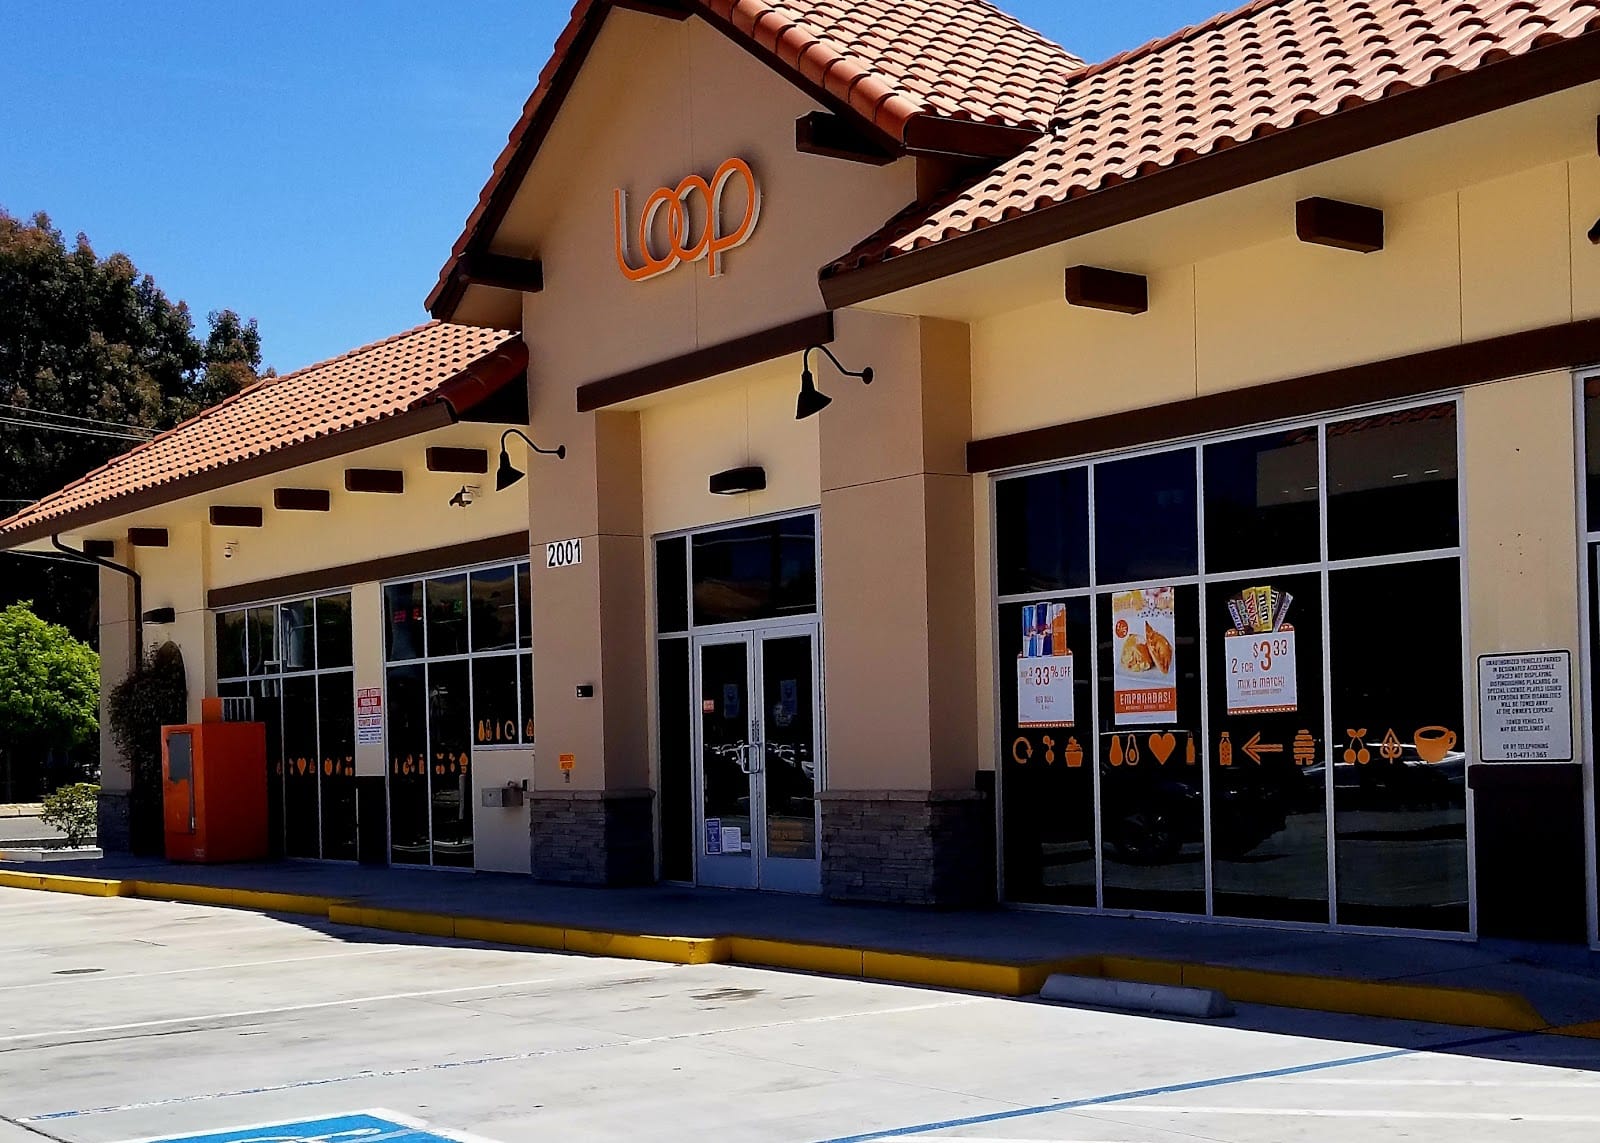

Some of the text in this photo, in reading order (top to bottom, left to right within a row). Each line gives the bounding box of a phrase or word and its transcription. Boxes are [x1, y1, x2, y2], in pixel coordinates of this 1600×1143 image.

[548, 539, 581, 567] 2001
[1231, 658, 1254, 674] 2 FOR
[1035, 665, 1059, 686] 33%
[1060, 666, 1071, 678] OFF
[1237, 676, 1285, 689] MIX & MATCH!
[1119, 691, 1171, 705] EMPANADAS!
